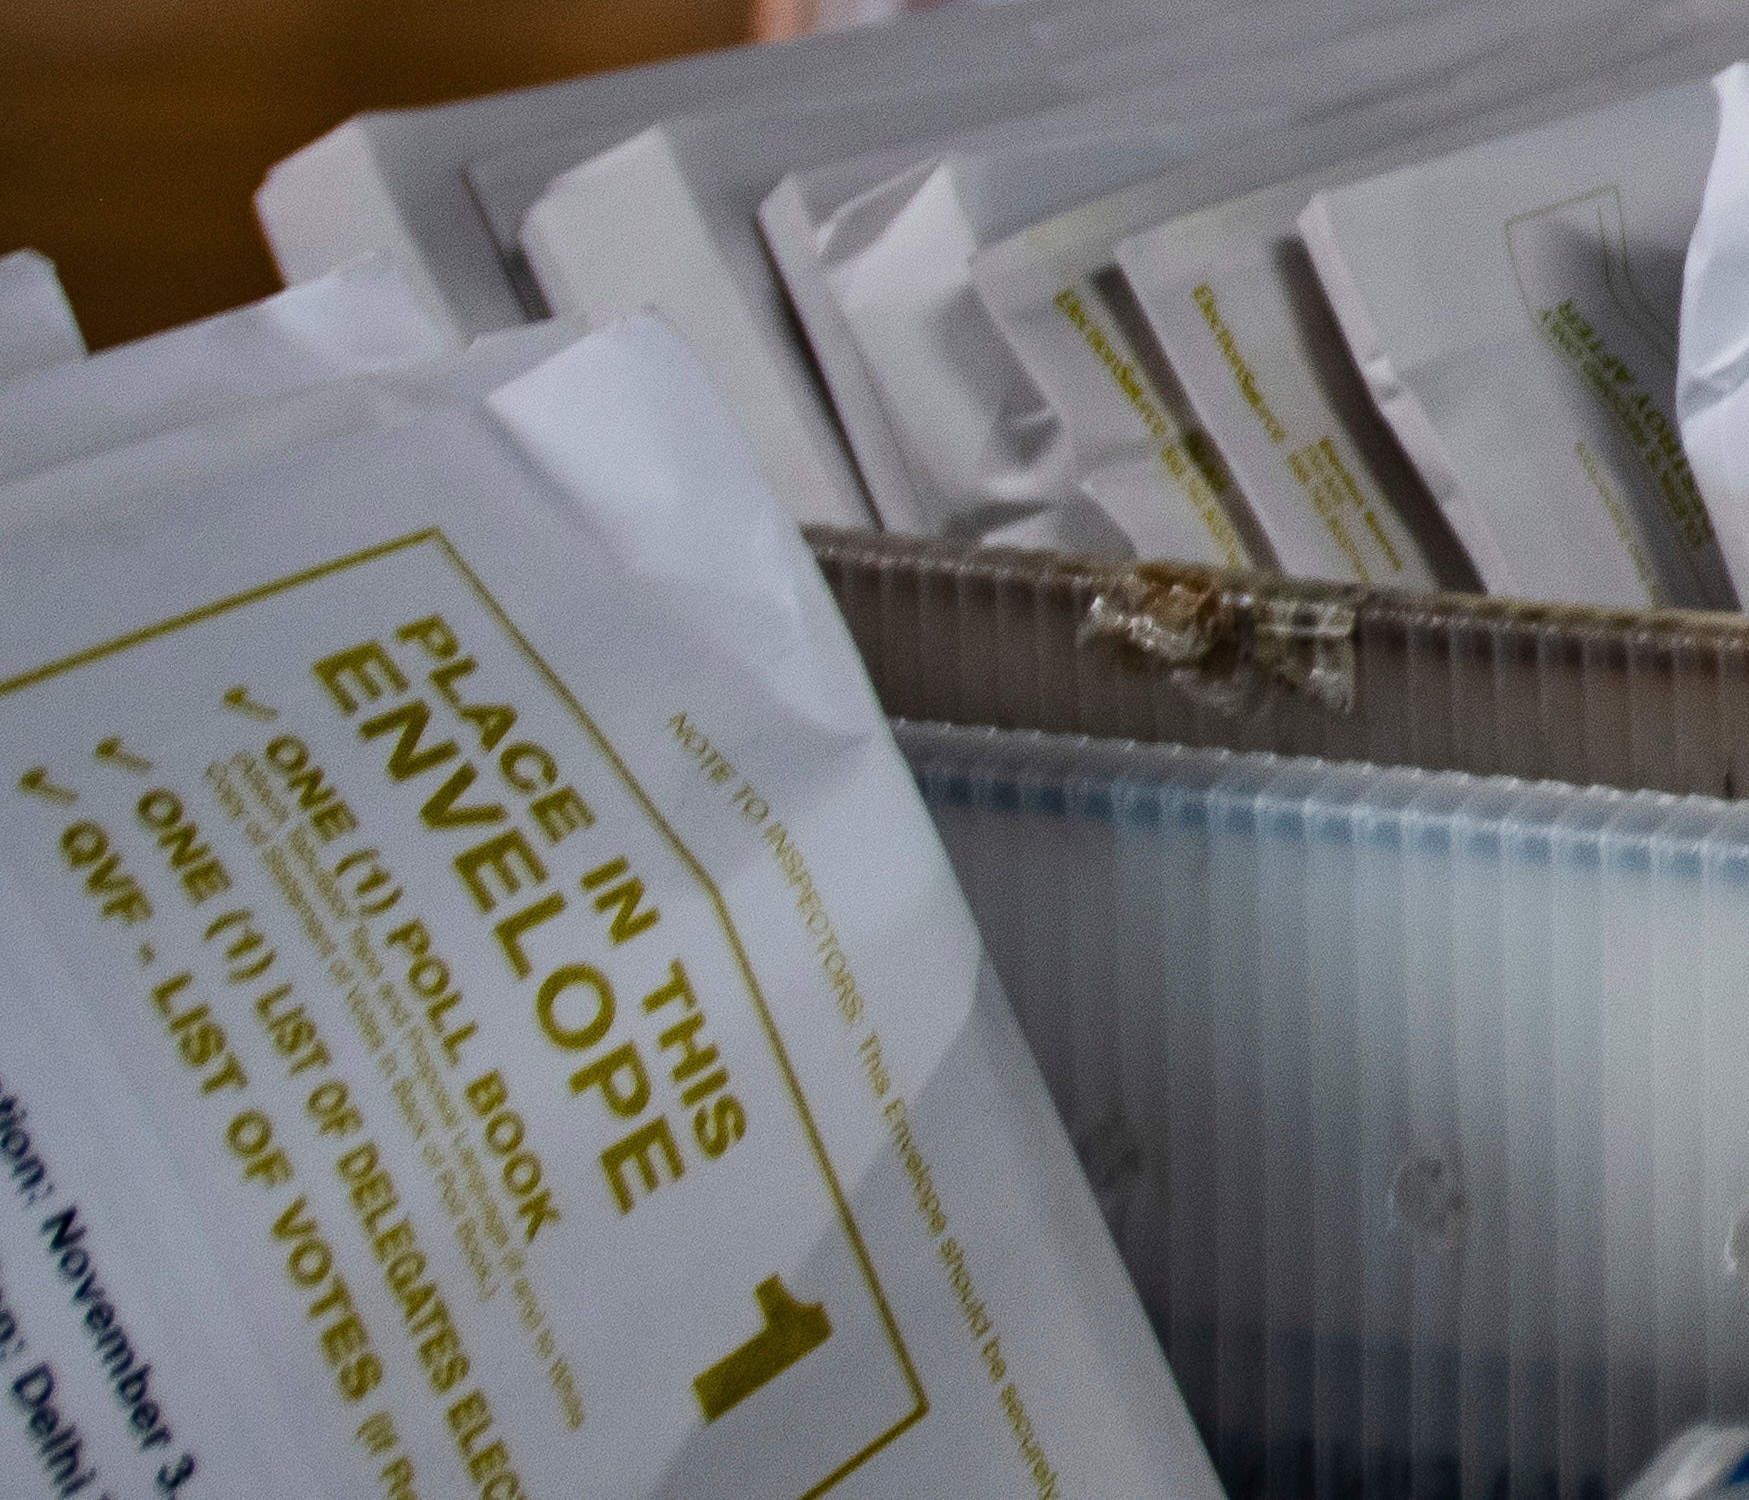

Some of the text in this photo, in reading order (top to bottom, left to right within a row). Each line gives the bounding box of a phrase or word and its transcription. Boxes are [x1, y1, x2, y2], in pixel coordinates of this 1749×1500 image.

[60, 823, 150, 922] QVF
[151, 974, 245, 1093] LIST
[226, 1112, 290, 1182] OF
[272, 1199, 381, 1401] VOTES
[136, 791, 228, 901] ONE
[204, 911, 274, 983] (1)
[255, 987, 328, 1073] LIST
[306, 1082, 361, 1134] OF
[337, 1144, 468, 1393] DELEGATES
[264, 737, 557, 1240] ONE (1) POLL BOOK
[312, 642, 683, 1213] ENVELOPE
[395, 616, 745, 1159] PLACE IN THIS
[667, 714, 732, 783] NOTE
[733, 783, 769, 824] TO
[859, 1033, 890, 1098] This
[883, 1099, 946, 1235] Envelope
[939, 1239, 992, 1339] should
[981, 1338, 1006, 1382] be
[0, 1092, 200, 1500] tion: November 3
[11, 1361, 99, 1499] Delhi
[691, 1275, 832, 1423] 1
